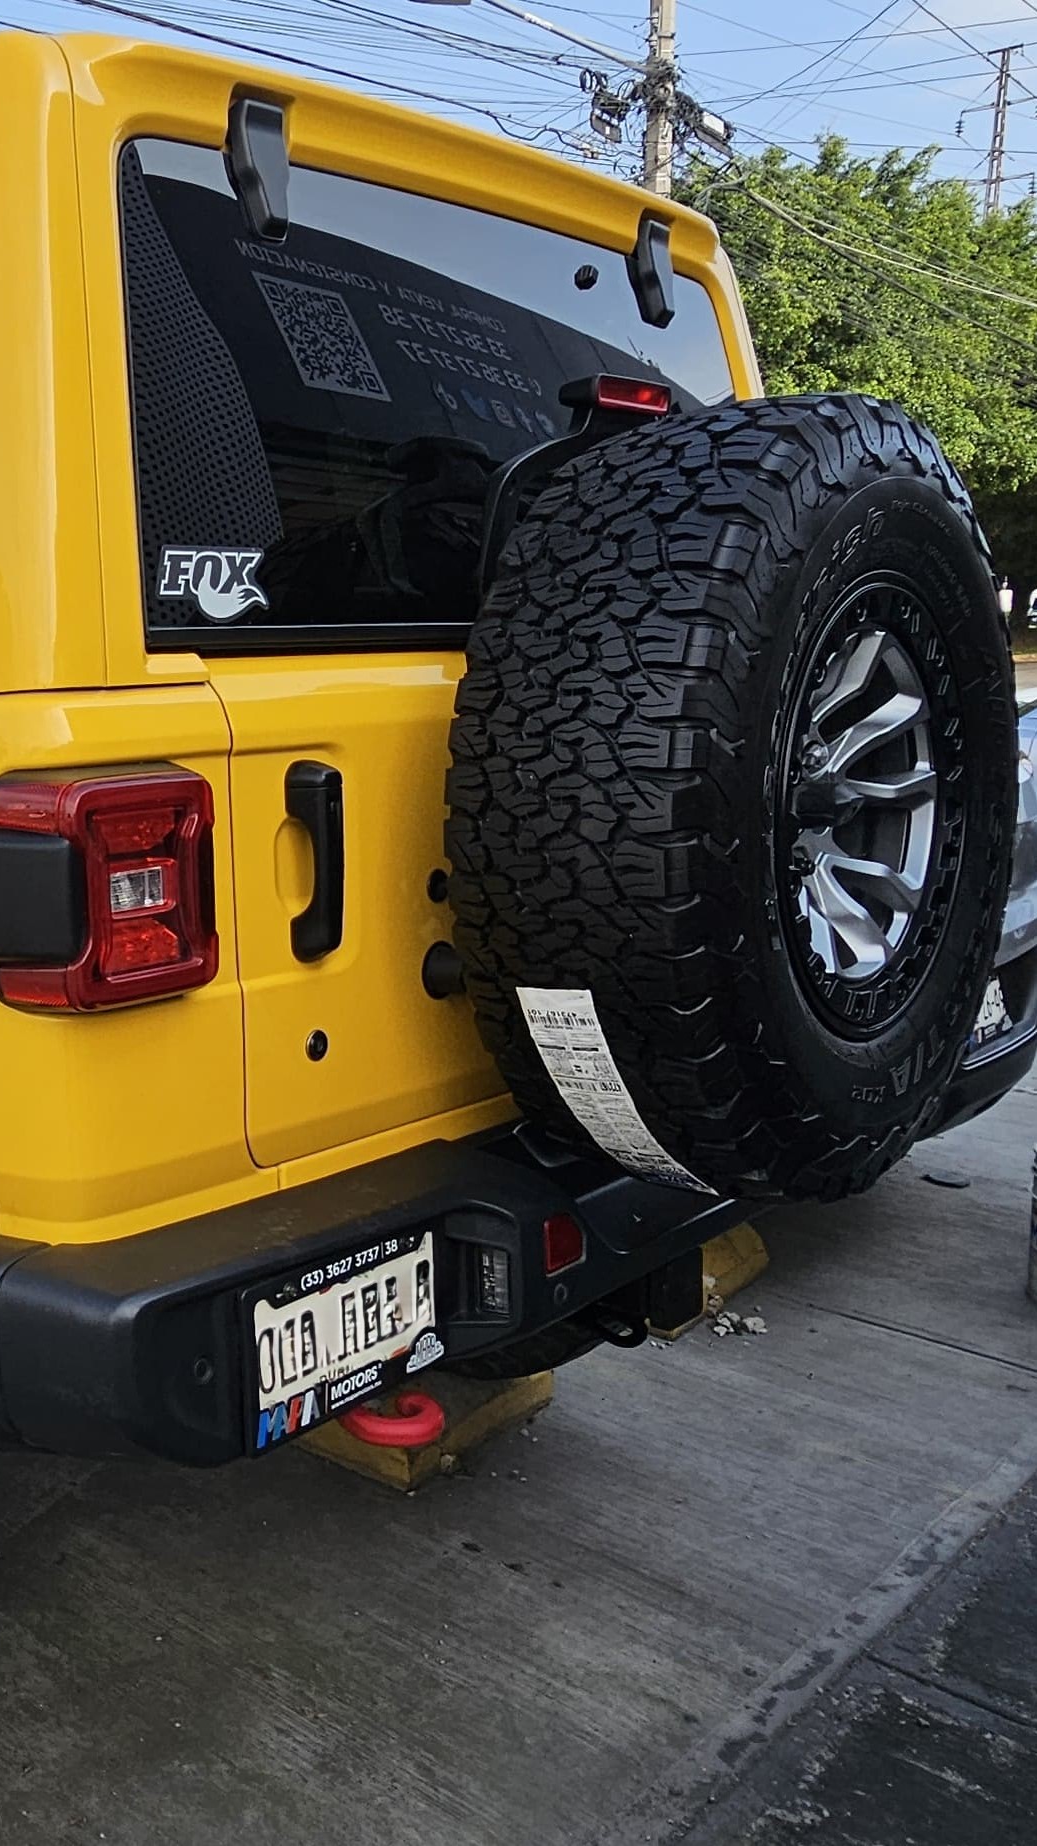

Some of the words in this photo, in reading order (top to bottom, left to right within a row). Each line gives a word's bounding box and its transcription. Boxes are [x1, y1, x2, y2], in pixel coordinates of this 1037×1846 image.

[160, 551, 263, 602] FOX
[300, 1269, 324, 1291] (33)
[326, 1256, 353, 1279] 3627
[330, 1367, 378, 1401] MOTORS
